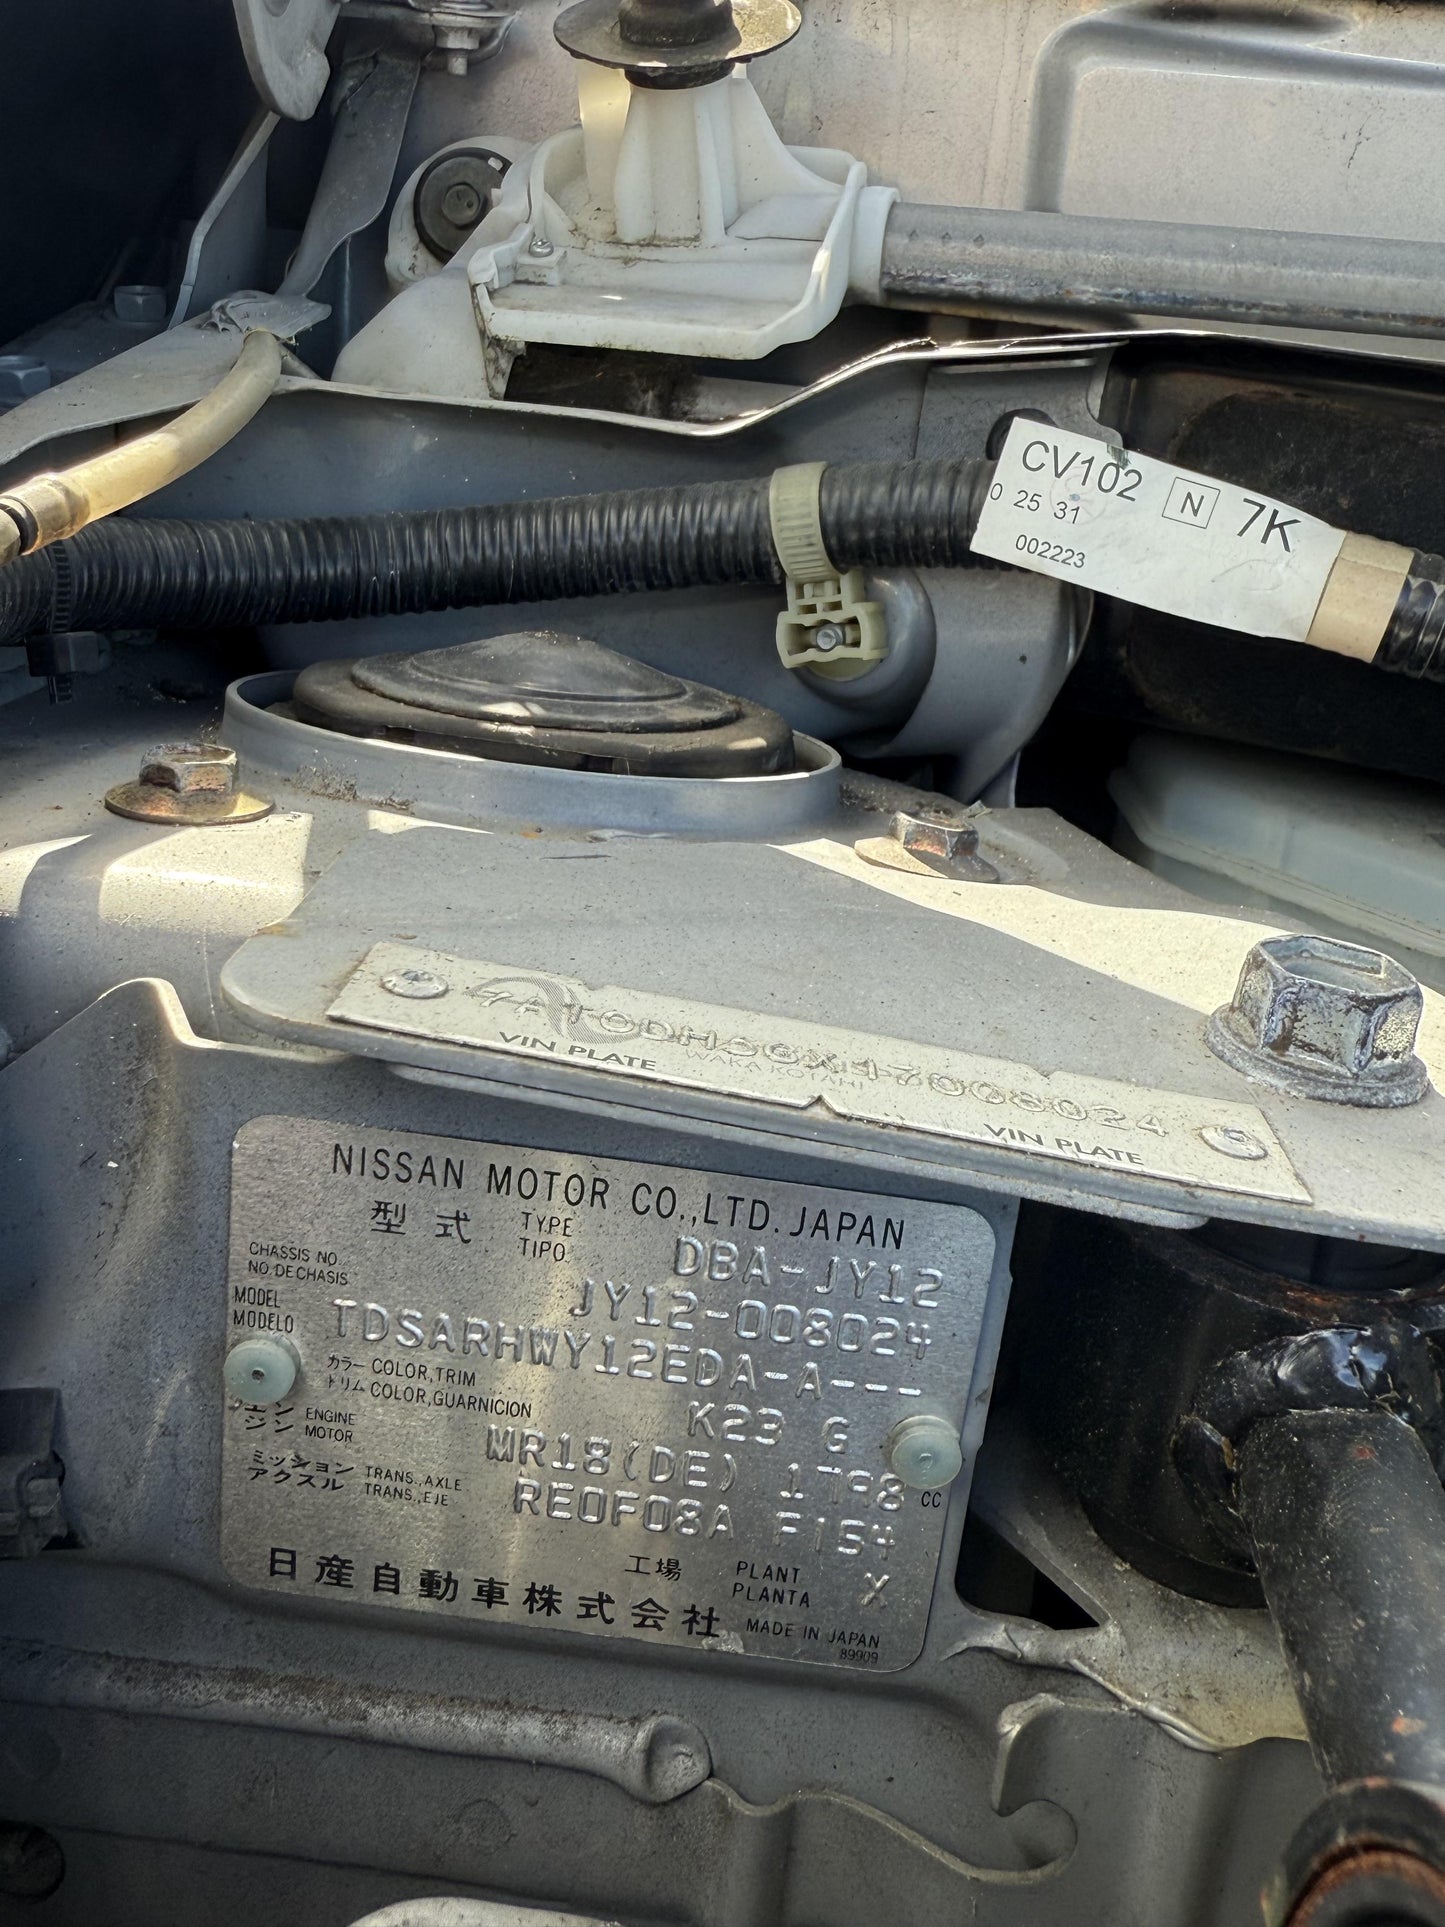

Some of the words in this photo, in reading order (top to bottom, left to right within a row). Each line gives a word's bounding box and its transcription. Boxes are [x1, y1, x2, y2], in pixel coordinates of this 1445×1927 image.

[989, 483, 1004, 501] 0
[1013, 489, 1043, 512] 25
[1053, 500, 1081, 525] 31
[1021, 440, 1143, 502] CV102
[1180, 491, 1206, 517] N
[1236, 498, 1302, 553] 7K
[1015, 534, 1086, 568] 002223
[499, 1032, 557, 1052] VIN
[569, 1044, 656, 1071] PLATE
[984, 1123, 1044, 1147] VIN
[1055, 1137, 1144, 1166] PLATE
[332, 1143, 465, 1190] NISSAN
[487, 1162, 610, 1210] MOTOR
[789, 1206, 904, 1250] JAPAN
[521, 1211, 574, 1237] TYPE
[249, 1241, 310, 1262] CHASSIS
[519, 1237, 566, 1262] TIPO
[673, 1233, 944, 1308] DBA-JY12
[233, 1285, 280, 1309] MODEL
[233, 1309, 294, 1334] MODELO
[569, 1278, 933, 1360] JY12-008024
[326, 1354, 365, 1371] カラー
[328, 1375, 365, 1392] トリム
[305, 1407, 357, 1426] ENGINE
[687, 1400, 787, 1446] K23
[822, 1415, 851, 1455] G
[305, 1425, 353, 1442] MOTOR
[253, 1449, 355, 1475] ミッション
[486, 1423, 737, 1493] MR18(DE)
[779, 1462, 905, 1512] 1798
[920, 1491, 942, 1509] CC
[247, 1466, 345, 1491] アクスル
[772, 1511, 896, 1562] F154
[624, 1554, 683, 1582] 工場
[736, 1560, 801, 1584] PLANT
[269, 1547, 721, 1639] 日産自動車株式会社
[732, 1582, 810, 1608] PLANTA
[746, 1618, 795, 1637] MADE
[803, 1625, 820, 1641] IN
[828, 1628, 881, 1649] JAPAN
